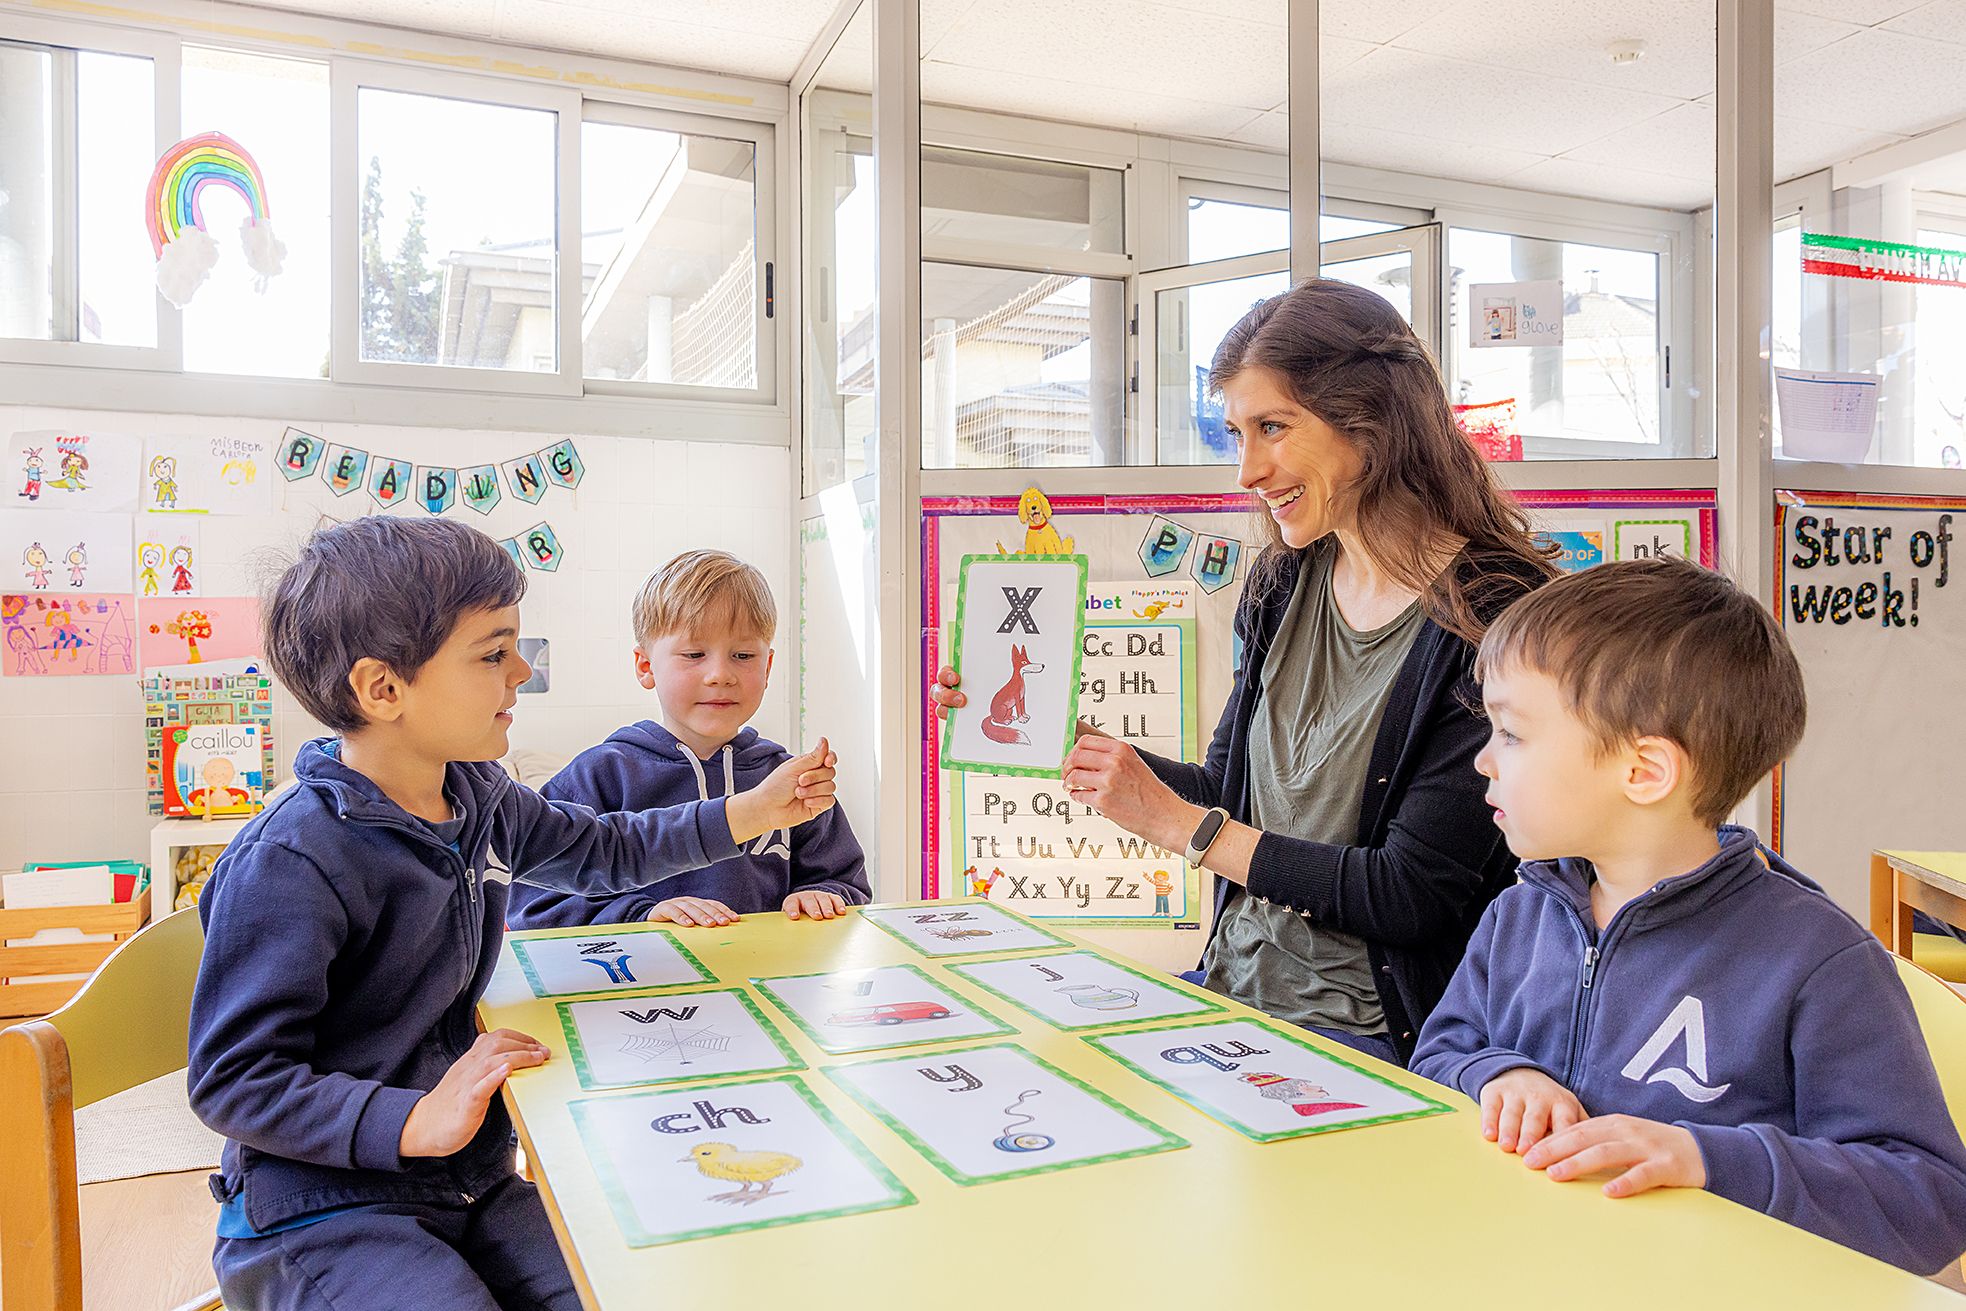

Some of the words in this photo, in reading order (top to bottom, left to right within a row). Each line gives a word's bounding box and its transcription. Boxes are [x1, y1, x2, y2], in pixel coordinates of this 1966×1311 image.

[289, 440, 572, 500] READING
[1792, 516, 1892, 569] Star
[1910, 514, 1953, 588] of
[1791, 571, 1919, 628] week!
[1127, 633, 1165, 656] Dd
[1120, 671, 1158, 694] Hh
[191, 728, 253, 750] caillou
[984, 792, 1017, 824] Pp
[1032, 792, 1074, 824] Qq
[971, 835, 1001, 858] Tt
[1017, 836, 1056, 859] Uu
[1066, 837, 1104, 859] Vv
[1008, 876, 1047, 899] Xx
[1057, 876, 1090, 909] Yy
[1106, 876, 1140, 899] Zz
[651, 1100, 772, 1135] ch
